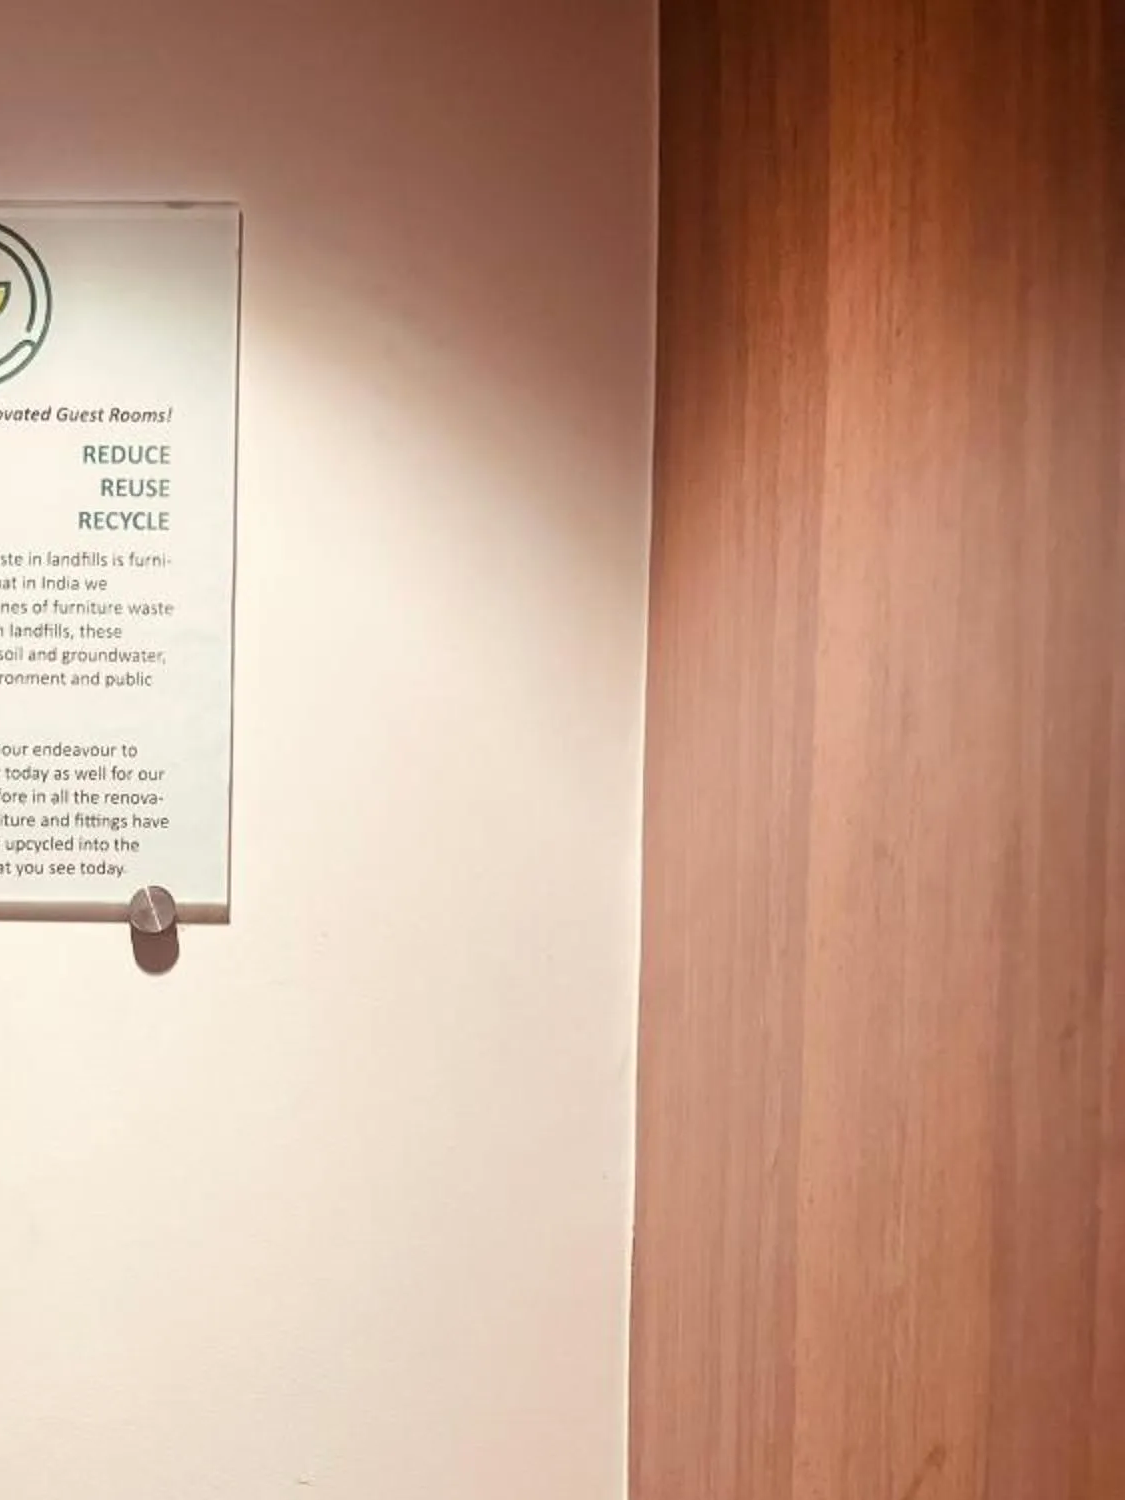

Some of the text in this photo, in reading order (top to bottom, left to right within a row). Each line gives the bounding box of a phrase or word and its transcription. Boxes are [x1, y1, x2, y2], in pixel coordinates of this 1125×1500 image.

[56, 407, 104, 423] Guest
[109, 407, 172, 423] Rooms!
[83, 445, 170, 464] REDUCE
[101, 478, 170, 498] REUSE
[79, 511, 169, 531] RECYCLE
[28, 552, 42, 567] in
[47, 551, 108, 568] landfills
[112, 553, 124, 567] is
[128, 551, 171, 567] furni-
[23, 576, 36, 590] in
[41, 576, 80, 591] India
[85, 579, 107, 591] we
[32, 599, 48, 615] of
[52, 600, 123, 616] furniture
[127, 602, 174, 616] waste
[10, 622, 74, 640] landfills,
[79, 623, 122, 639] these
[28, 647, 57, 662] and
[61, 647, 165, 665] groundwater,
[71, 671, 100, 686] and
[105, 671, 152, 688] public
[0, 745, 29, 757] our
[32, 742, 117, 758] endeavour
[121, 744, 138, 758] to
[5, 766, 49, 783] today
[53, 769, 70, 781] as
[74, 765, 107, 781] well
[110, 765, 134, 781] for
[138, 769, 165, 781] our
[32, 788, 46, 804] in
[50, 788, 69, 806] all
[73, 789, 100, 805] the
[104, 793, 163, 805] renova-
[40, 812, 70, 828] and
[74, 812, 128, 832] fittings
[132, 813, 169, 828] have
[5, 835, 74, 854] upcycled
[78, 836, 110, 853] into
[114, 836, 139, 852] the
[15, 863, 44, 877] you
[48, 863, 75, 875] see
